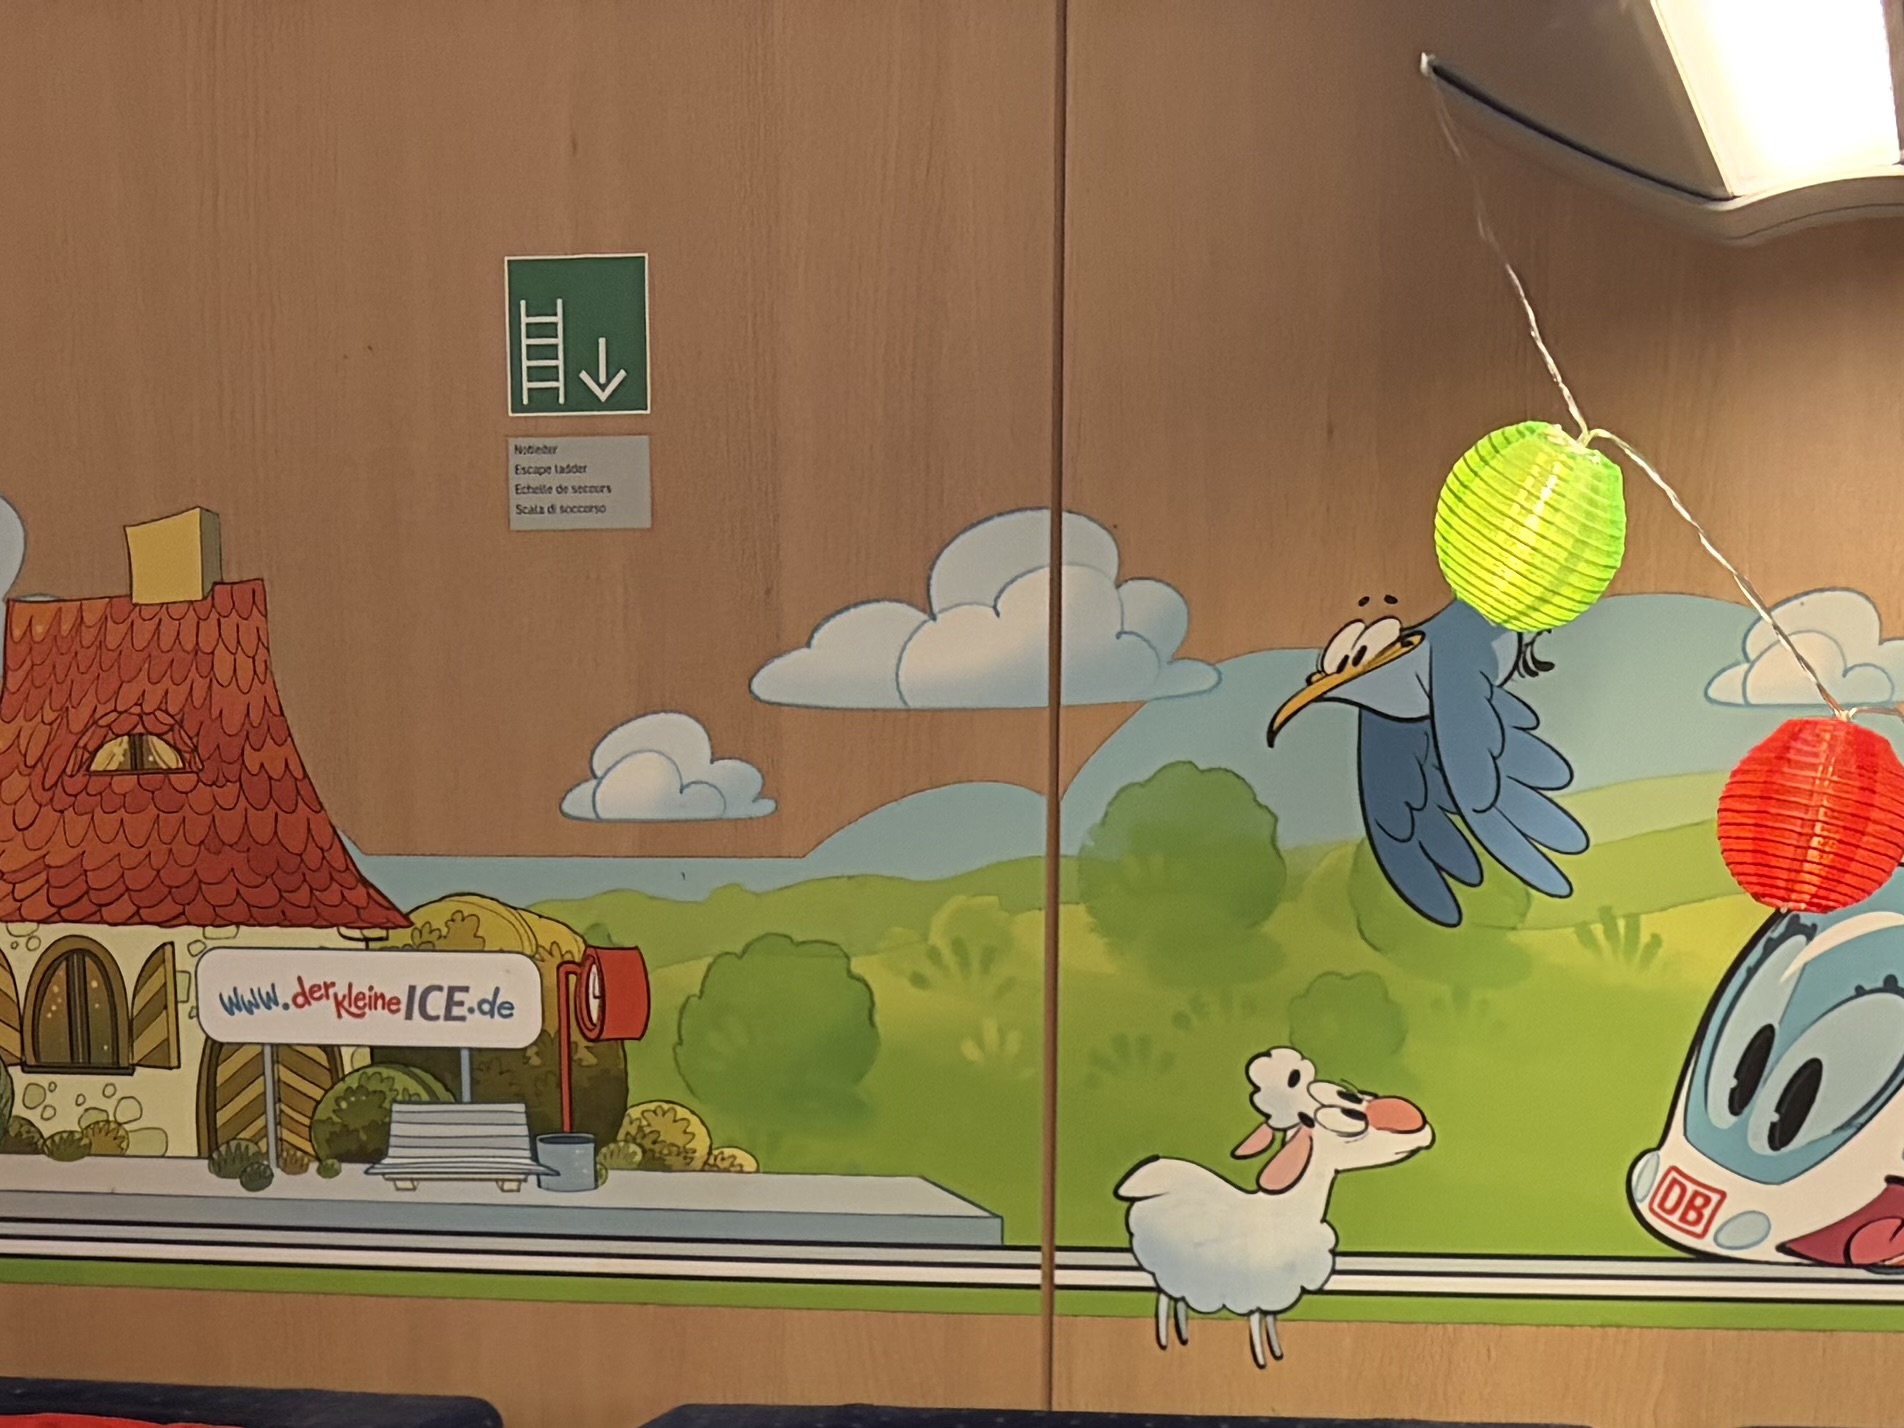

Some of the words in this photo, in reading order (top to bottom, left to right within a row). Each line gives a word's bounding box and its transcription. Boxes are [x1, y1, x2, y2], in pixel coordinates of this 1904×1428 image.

[514, 463, 552, 476] Escape
[555, 484, 569, 495] de
[1658, 1180, 1716, 1229] DB
